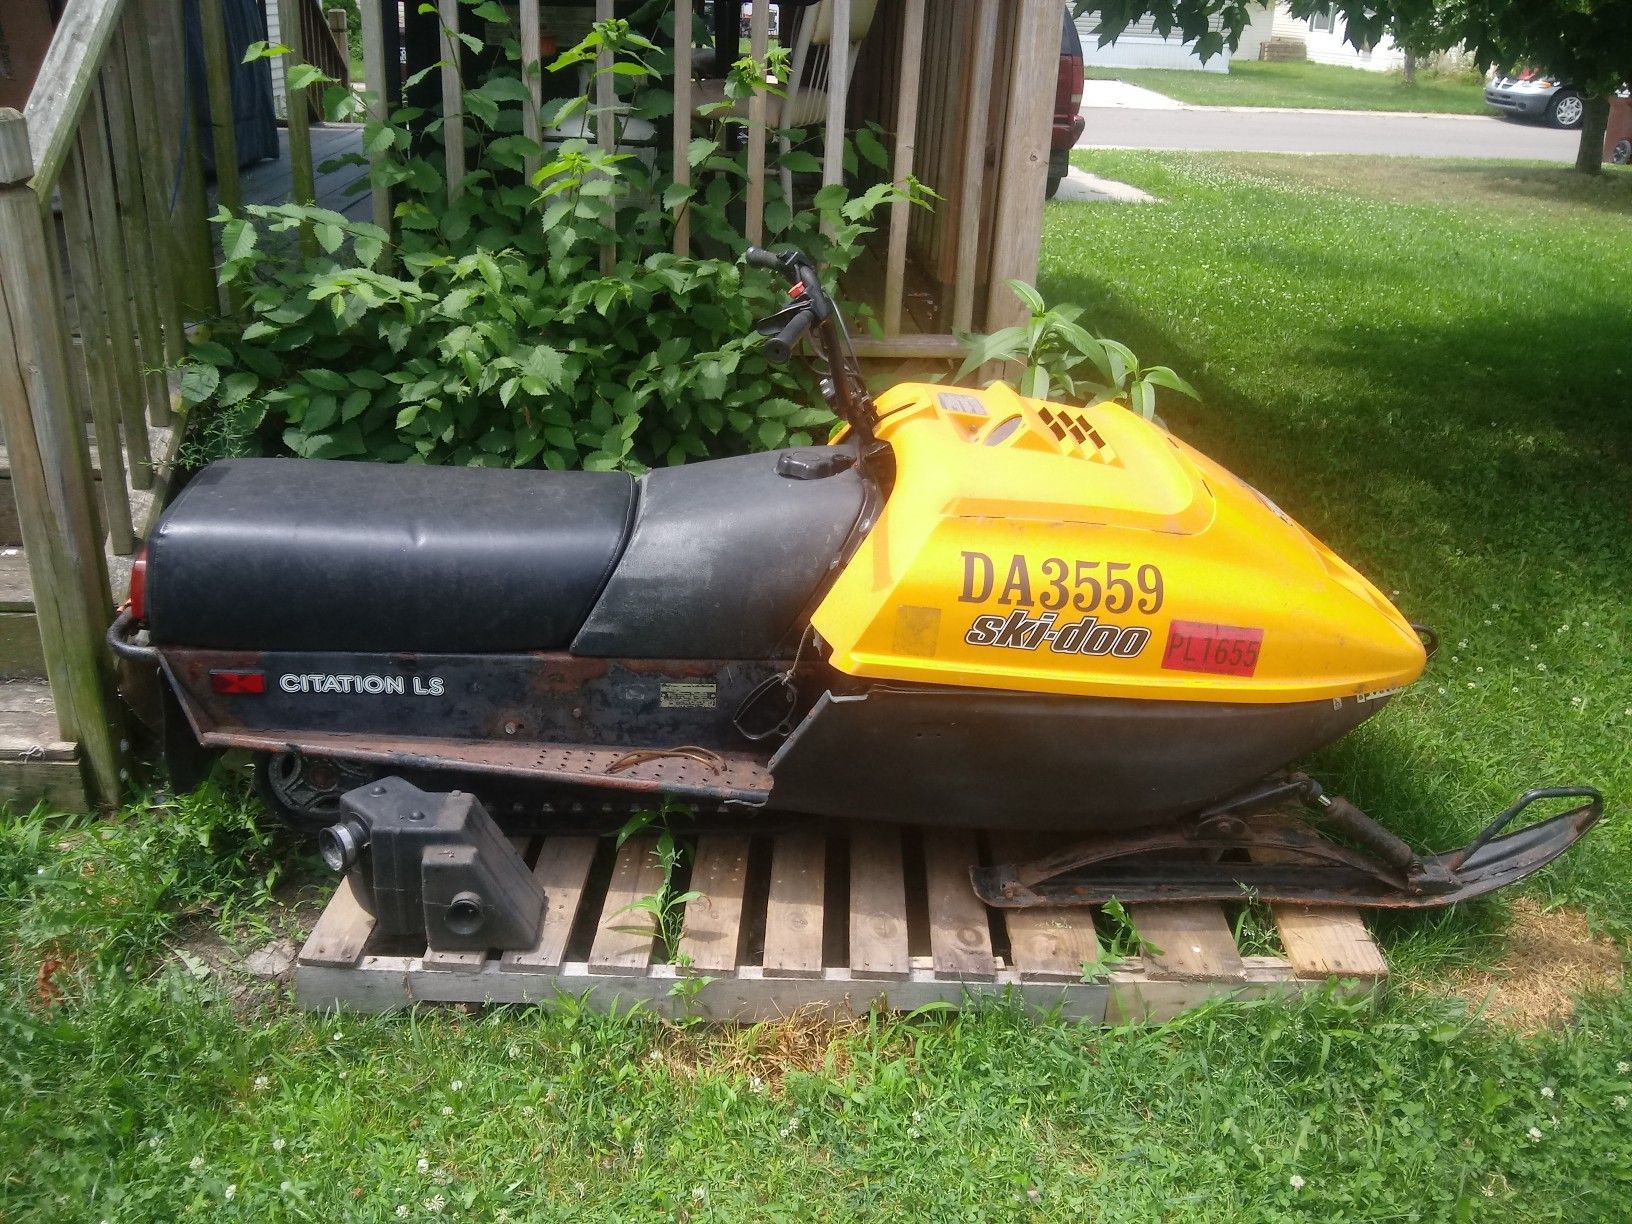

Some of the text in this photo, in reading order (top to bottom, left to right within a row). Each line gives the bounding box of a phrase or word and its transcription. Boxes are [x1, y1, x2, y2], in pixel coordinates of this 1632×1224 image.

[958, 550, 1164, 616] DA3559
[965, 609, 1152, 658] ski-doo
[1167, 632, 1260, 669] PL1655
[279, 673, 446, 696] CITATION LS
